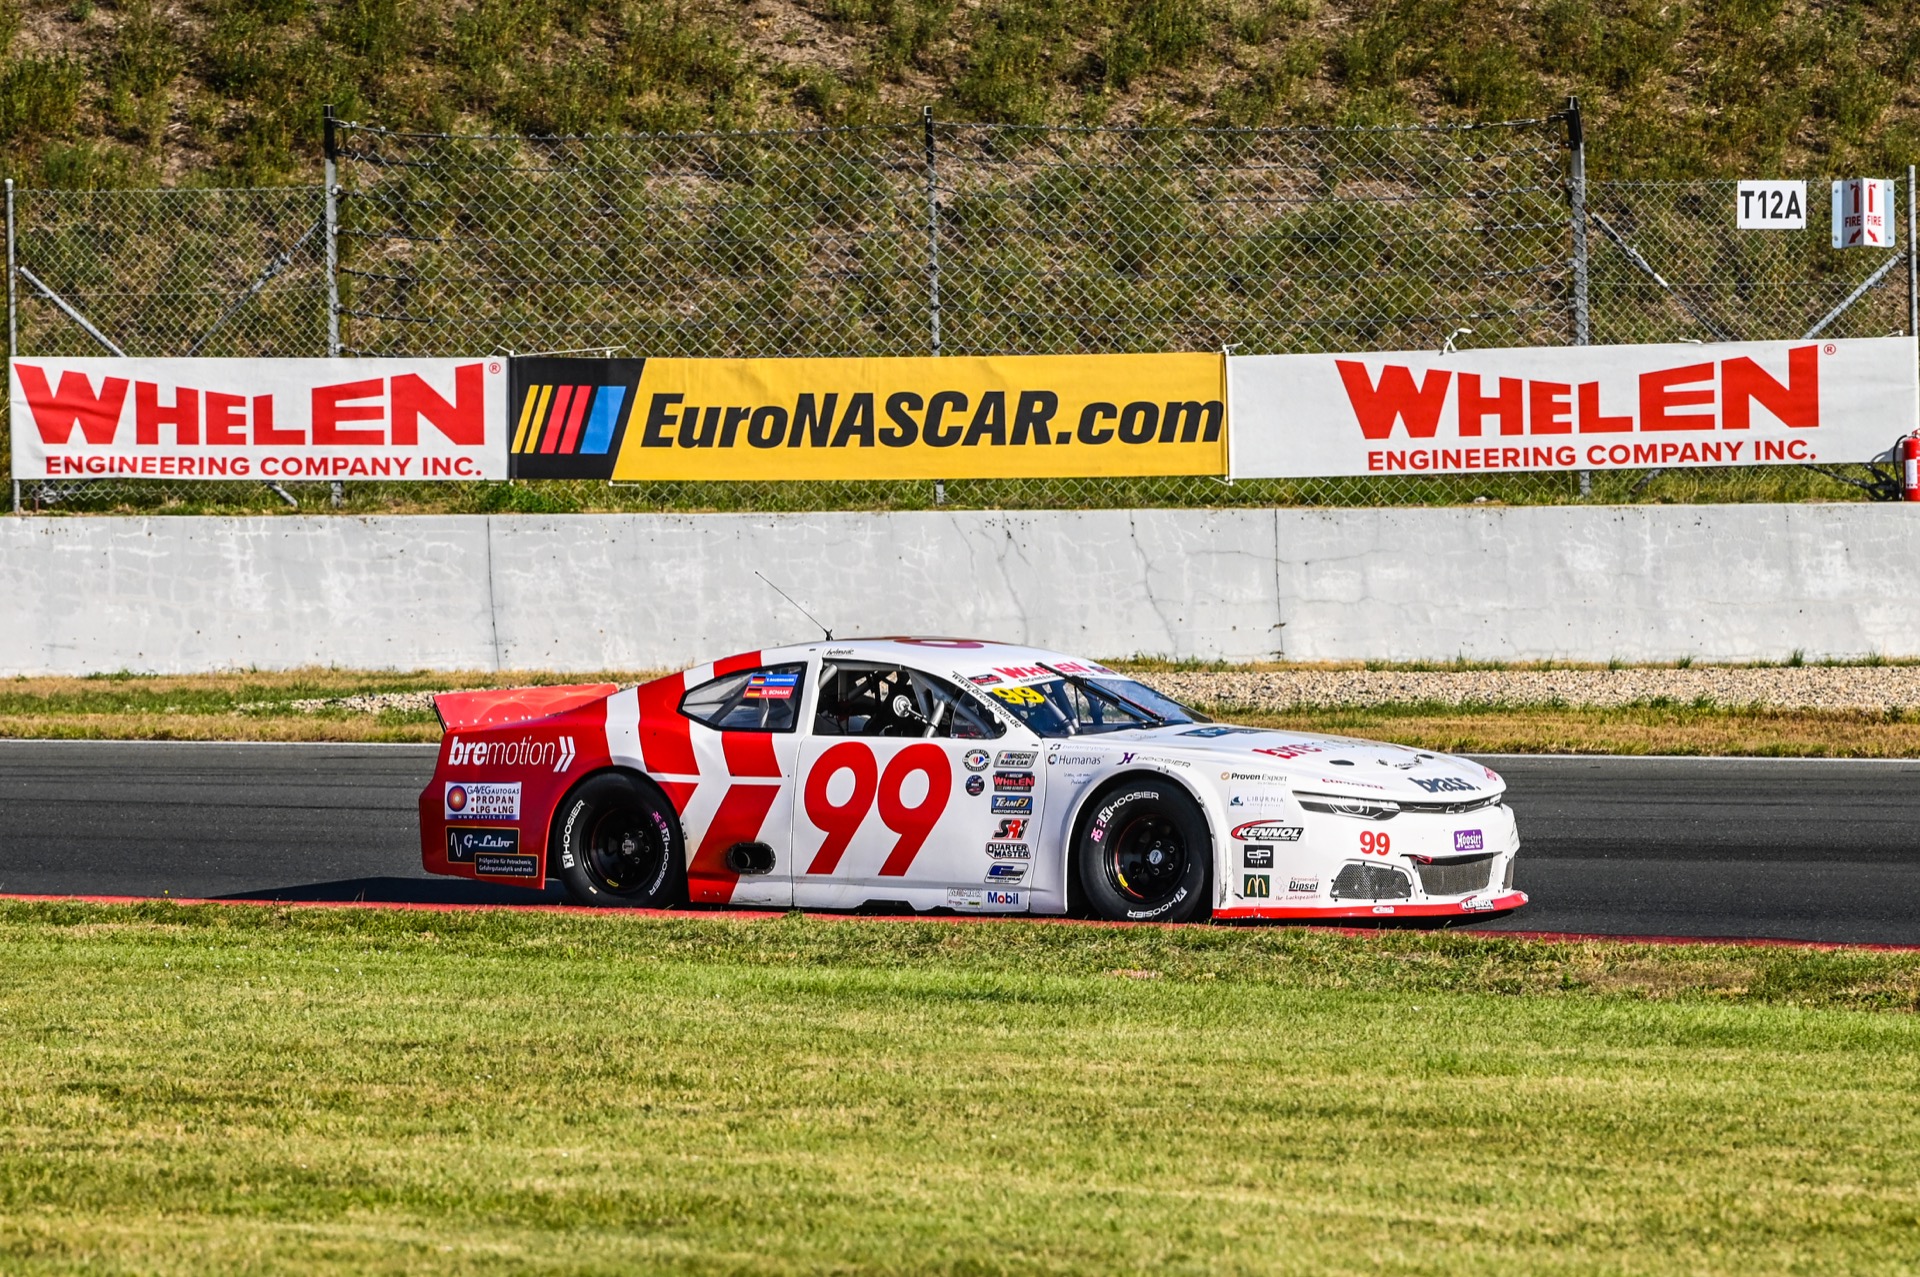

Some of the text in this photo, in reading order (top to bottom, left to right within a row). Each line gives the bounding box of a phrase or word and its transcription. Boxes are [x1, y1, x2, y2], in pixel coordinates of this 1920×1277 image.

[1740, 190, 1802, 219] T12A
[1845, 215, 1861, 227] FIRE
[1867, 216, 1882, 226] FIRE
[1335, 344, 1819, 440] WHELEN
[14, 363, 484, 446] WHELEN
[640, 390, 1224, 448] EuroNASCAR.com
[1368, 439, 1817, 471] ENGINEERING COMPANY INC.
[46, 456, 481, 476] ENGINEERING COMPANY INC.
[992, 686, 1045, 704] 99
[448, 735, 556, 766] bremotion
[1058, 754, 1101, 765] Humanas
[1137, 756, 1191, 768] HOOSIER
[993, 776, 1034, 786] WHELEN
[475, 795, 514, 804] PROPAN
[804, 741, 952, 876] 99
[1109, 791, 1160, 812] HOOSIER
[475, 805, 514, 814] LPG LNG
[563, 799, 585, 854] HOOSIER
[1237, 827, 1300, 837] KENNOL
[463, 834, 514, 848] G-Labo
[987, 843, 1027, 853] QUARTER
[1359, 830, 1391, 856] 99
[648, 842, 669, 895] HOOSIER
[987, 891, 1019, 904] Mobil
[1461, 899, 1493, 909] KENNOL
[1127, 898, 1176, 918] HOOSIER
